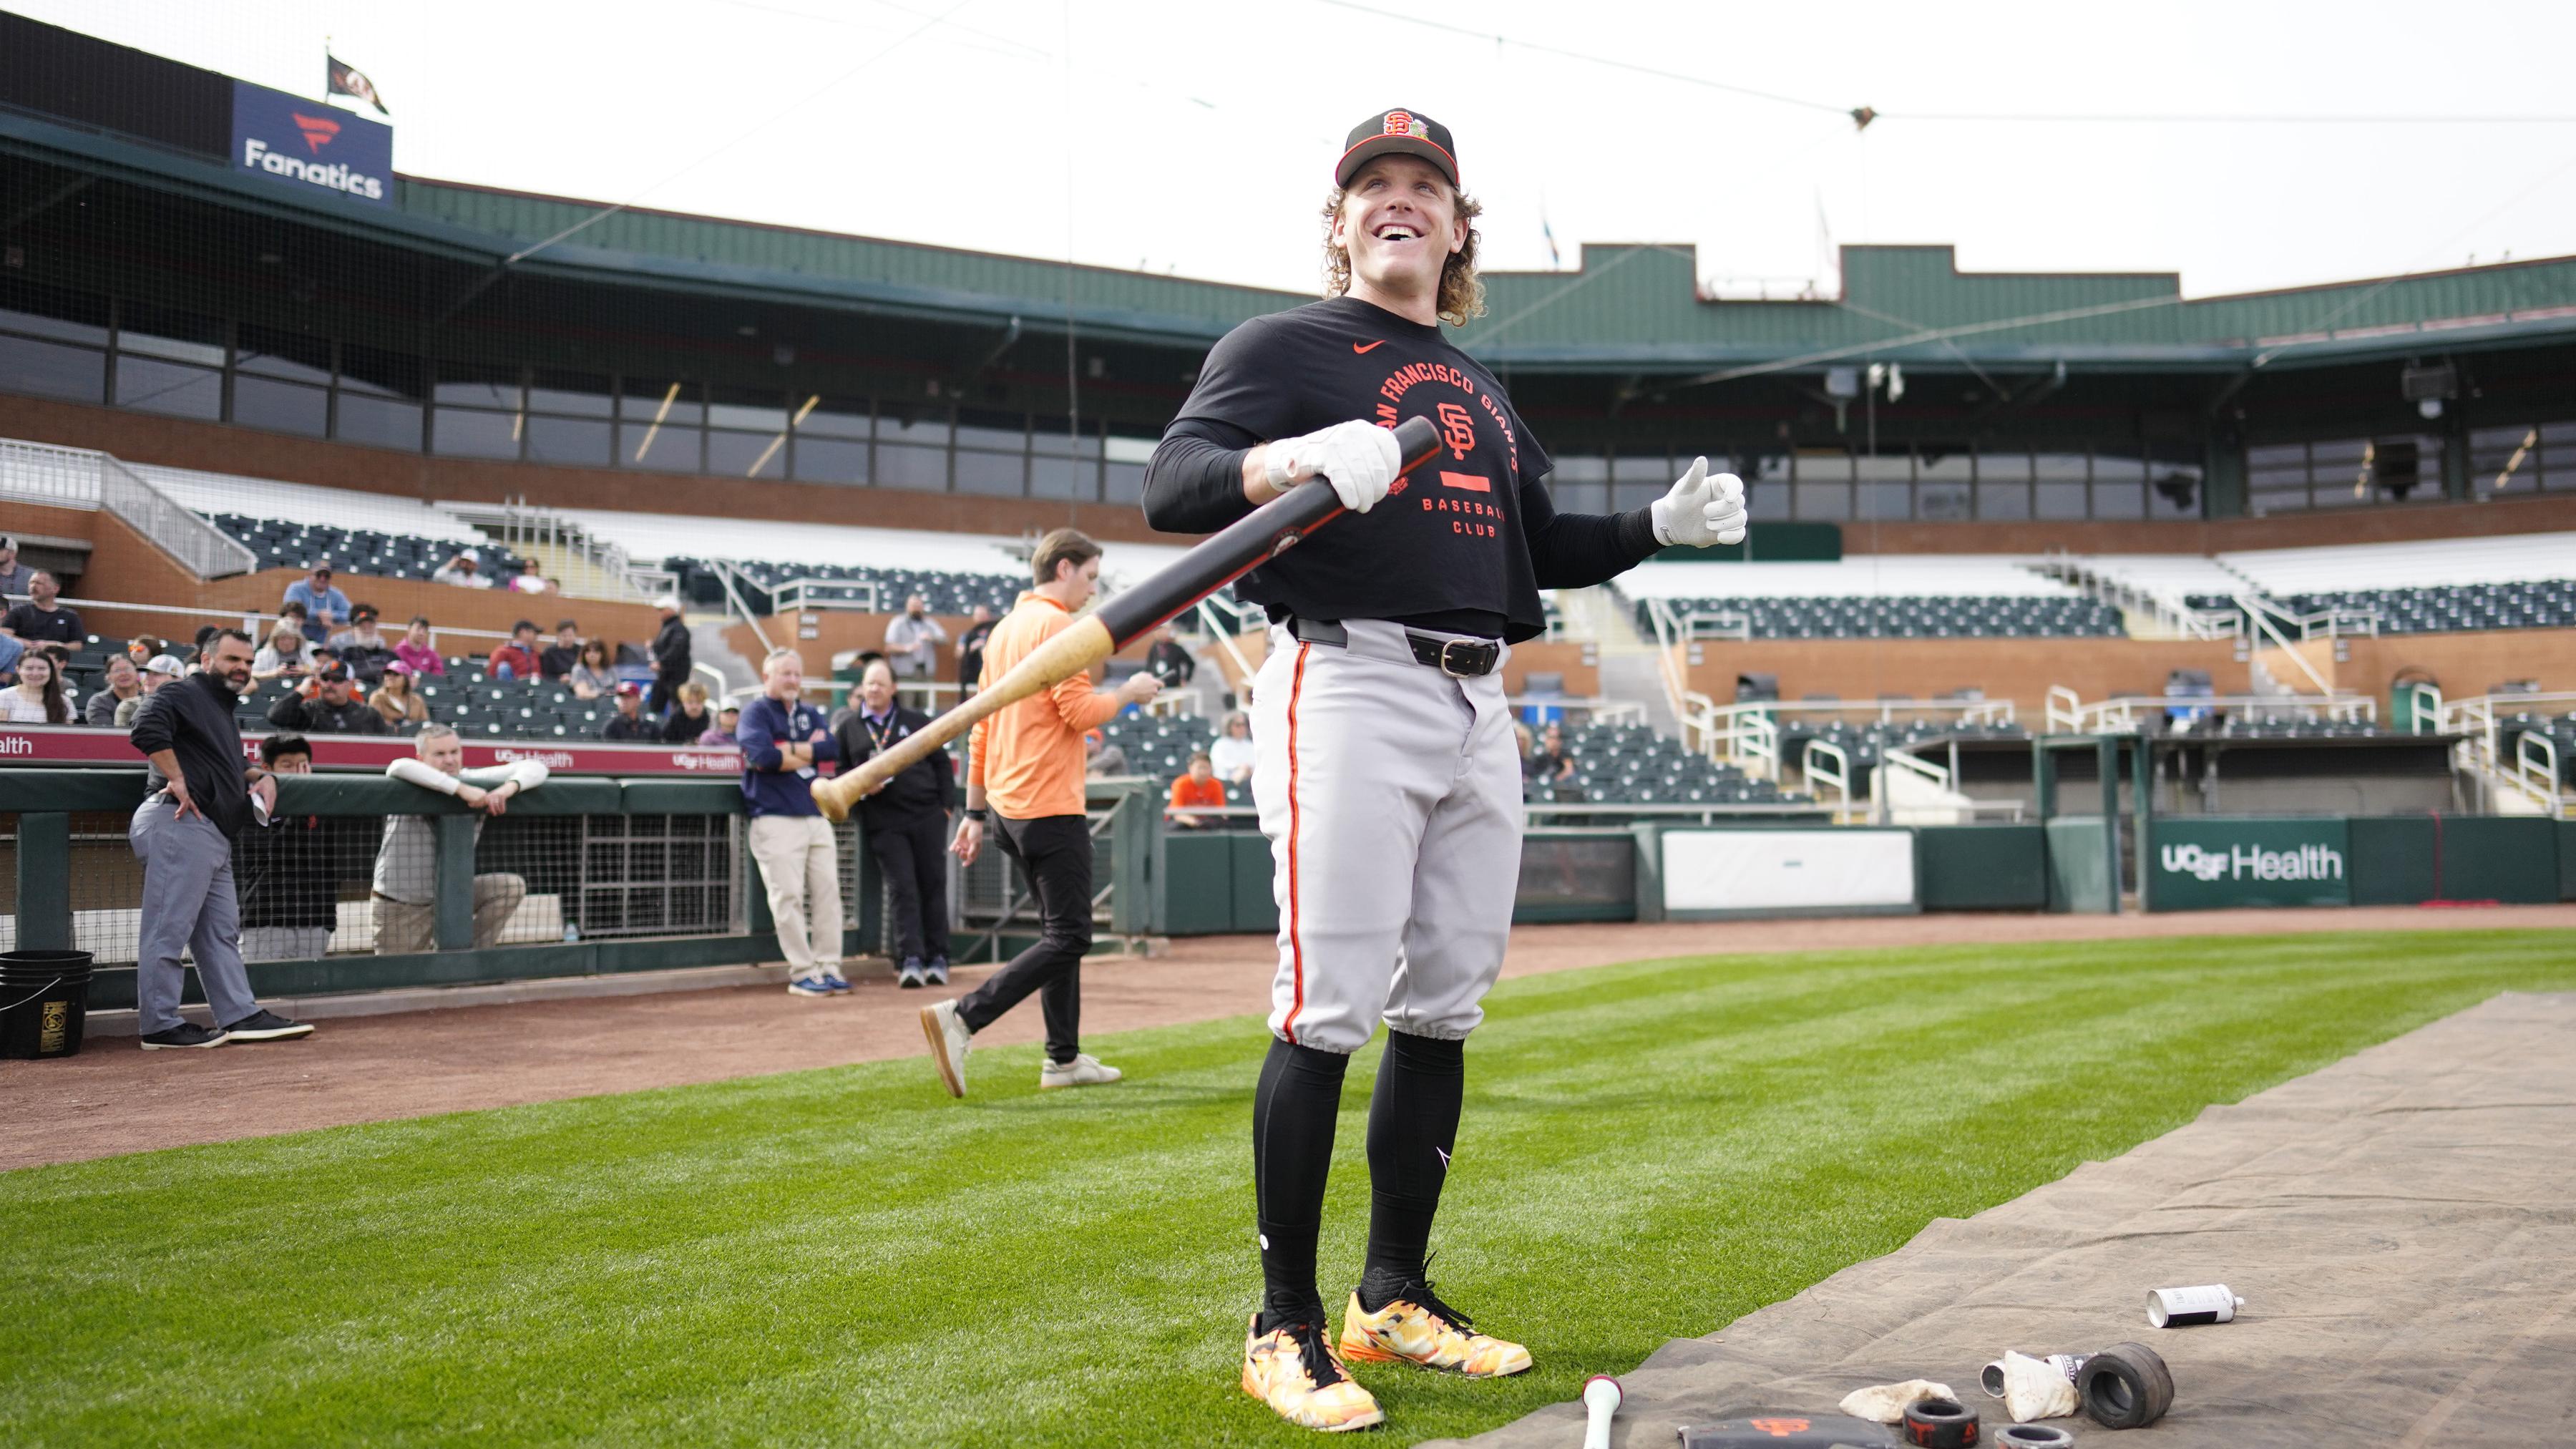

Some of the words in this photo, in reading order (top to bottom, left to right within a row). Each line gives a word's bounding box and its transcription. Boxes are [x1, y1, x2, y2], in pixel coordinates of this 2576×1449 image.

[244, 137, 384, 200] Fanatics
[1380, 362, 1474, 404] FRANCISCO
[1453, 520, 1496, 538] CLUB
[2231, 844, 2343, 881] Health
